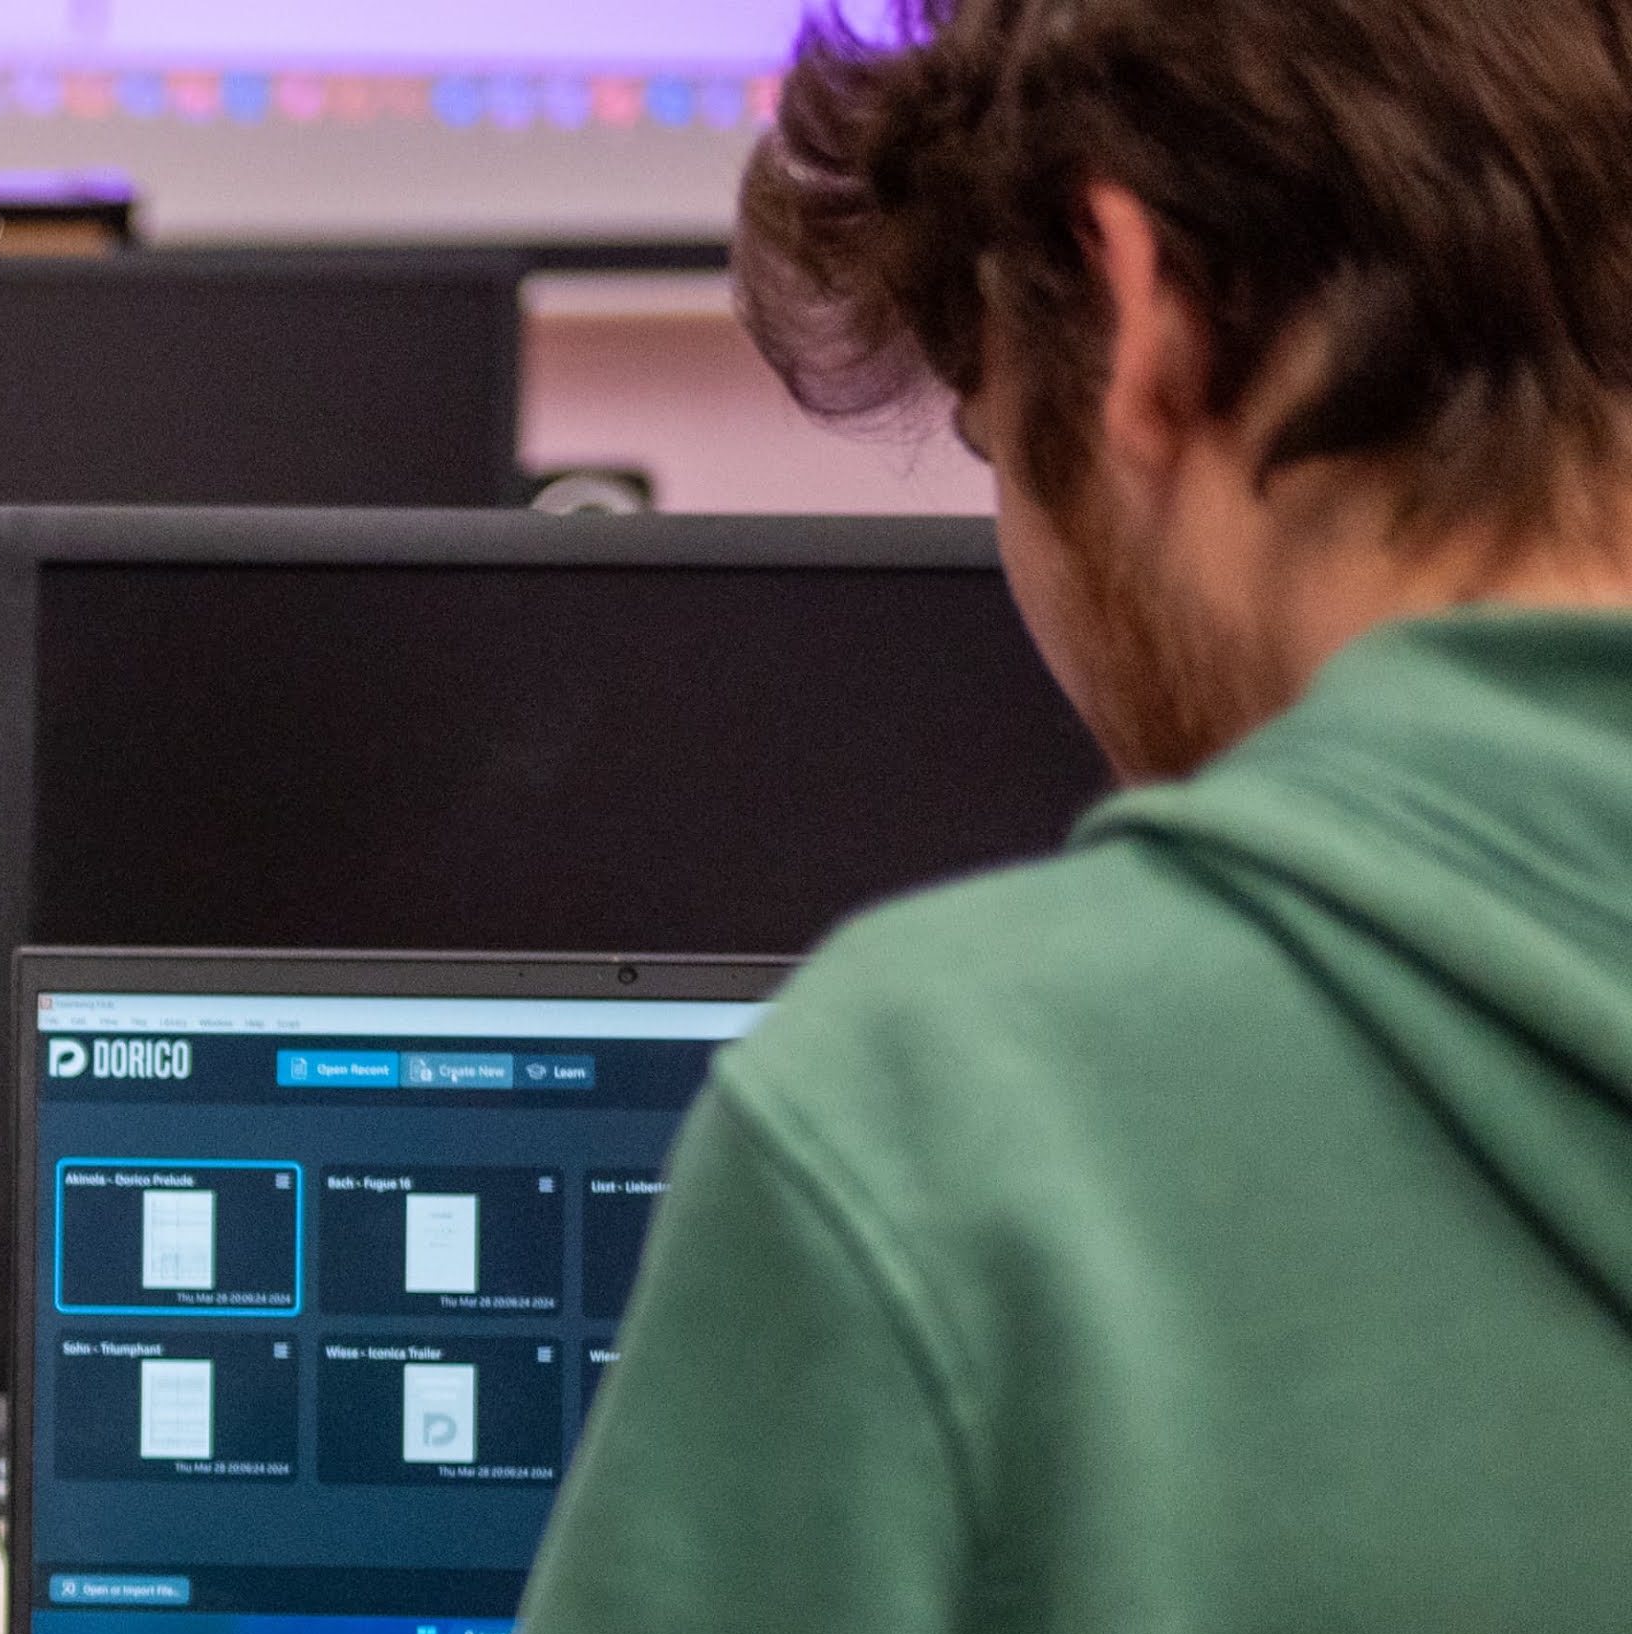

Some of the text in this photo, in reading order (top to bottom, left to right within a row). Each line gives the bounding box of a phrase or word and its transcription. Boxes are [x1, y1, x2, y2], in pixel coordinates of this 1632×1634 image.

[93, 1039, 190, 1079] DORICO
[317, 1064, 390, 1078] Open Recent
[438, 1065, 505, 1079] Create New
[553, 1065, 586, 1079] Learn
[65, 1173, 106, 1186] Akinola
[115, 1174, 150, 1186] Dorico
[152, 1173, 194, 1187] Prelude
[327, 1176, 354, 1190] Bach
[364, 1177, 398, 1193] Fugue
[591, 1180, 616, 1193] Liszt
[63, 1341, 90, 1356] Sohn
[101, 1341, 163, 1358] Triumphant
[325, 1346, 358, 1360] Wiese
[368, 1347, 406, 1360] Iconica
[408, 1347, 442, 1360] Trailer
[83, 1584, 108, 1597] Open
[122, 1585, 154, 1597] Import
